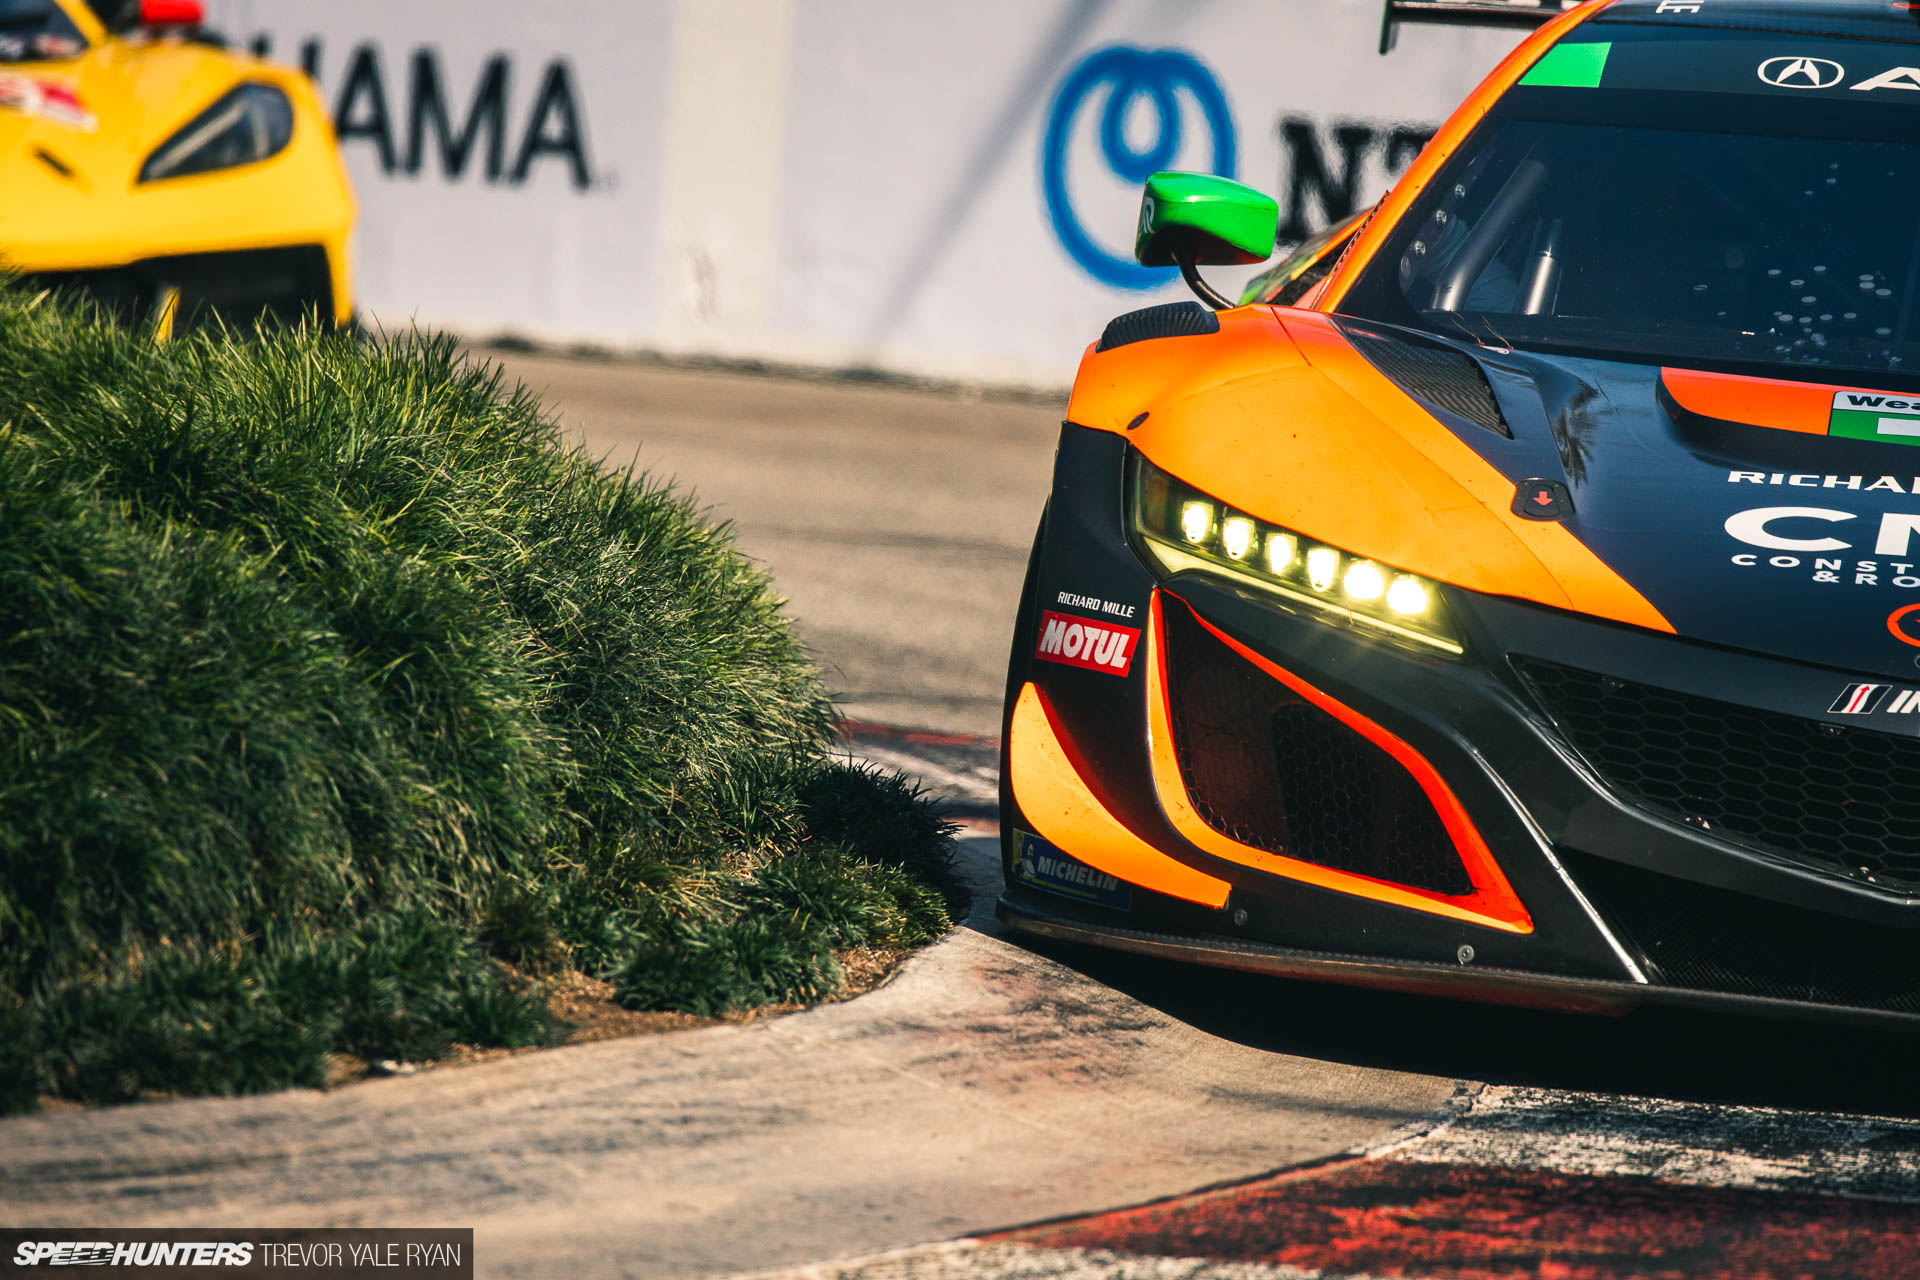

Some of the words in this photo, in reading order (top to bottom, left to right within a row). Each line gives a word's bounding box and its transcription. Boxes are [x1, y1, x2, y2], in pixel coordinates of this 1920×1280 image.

[250, 33, 594, 191] AMA
[1728, 470, 1920, 494] RICHA
[1057, 591, 1101, 611] RICHARD
[1101, 601, 1135, 618] MILLE
[1039, 618, 1130, 669] MOTUL
[1037, 856, 1118, 891] MICHELIN
